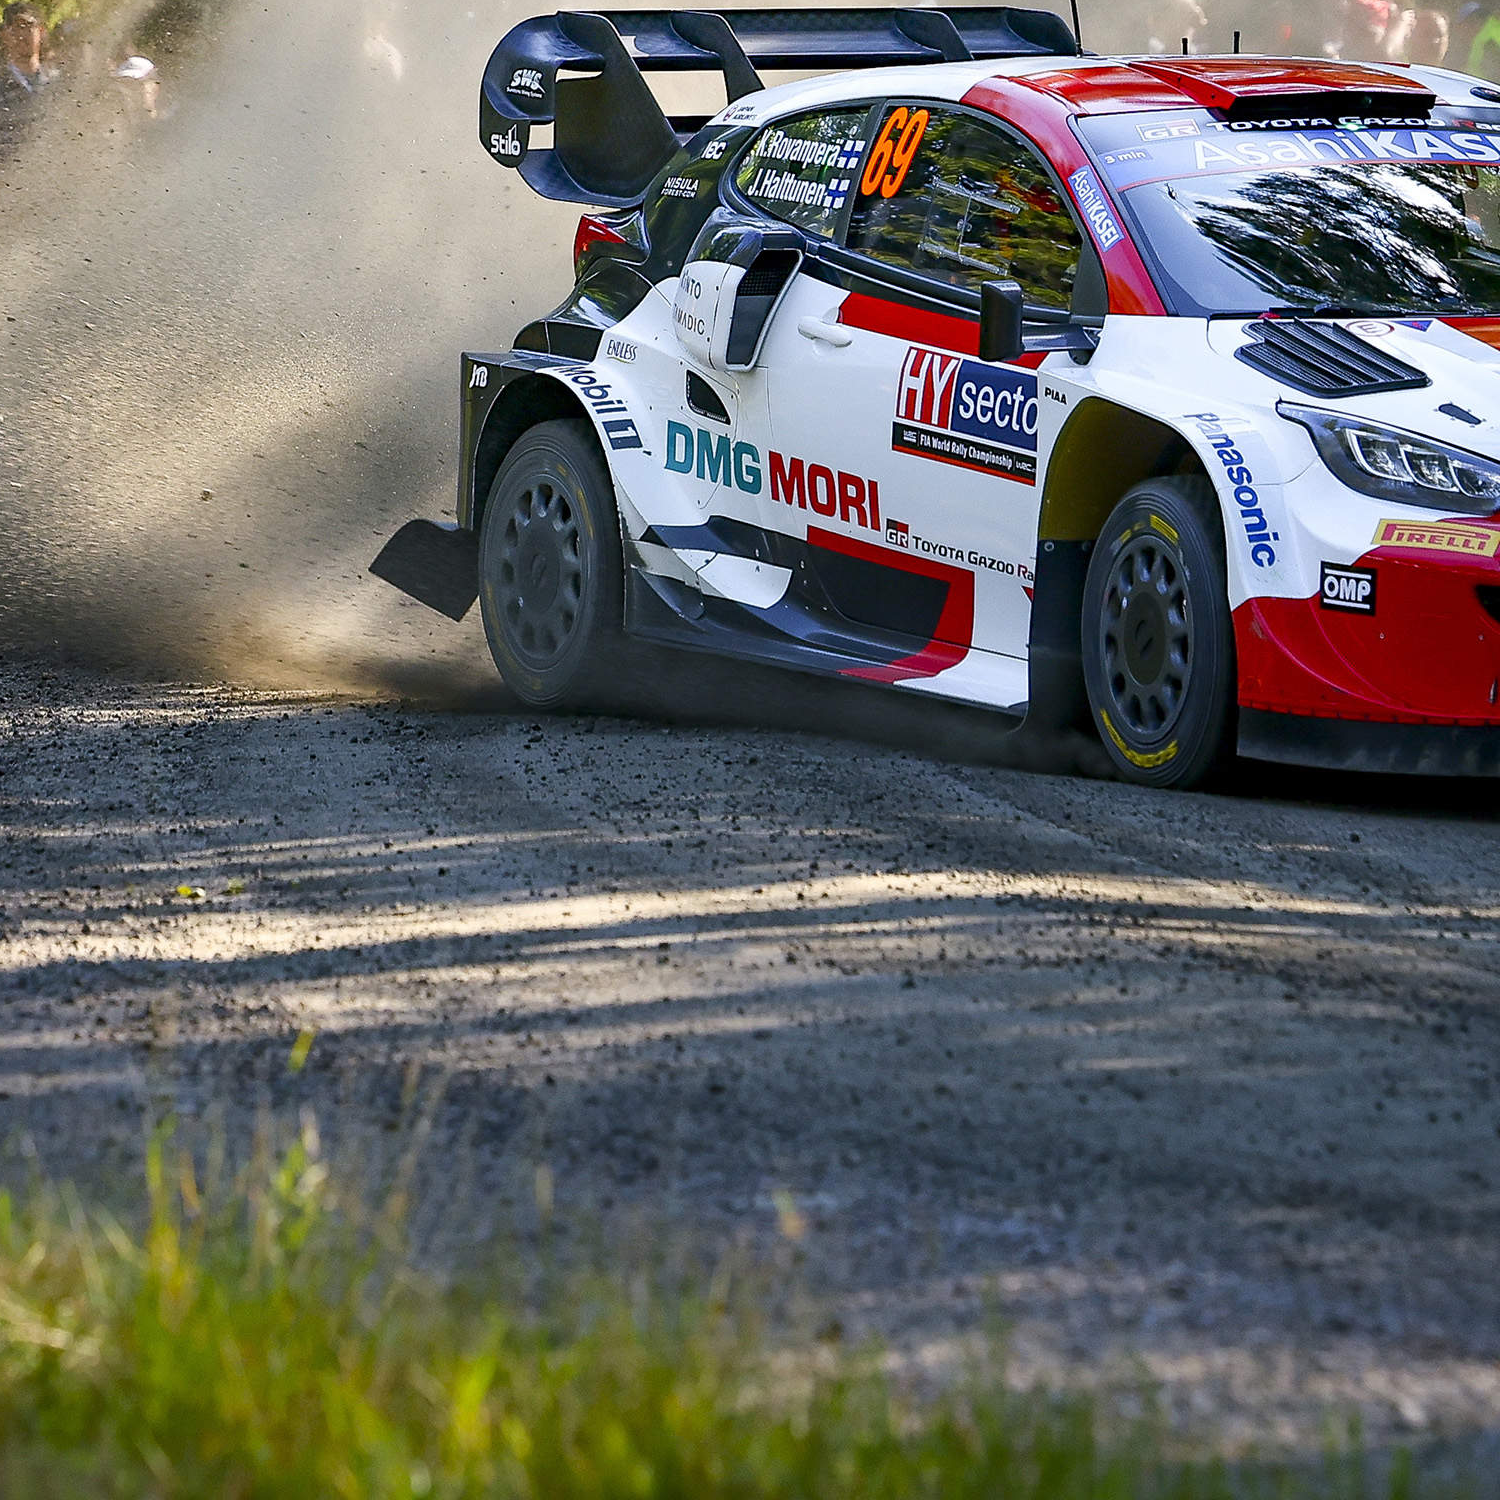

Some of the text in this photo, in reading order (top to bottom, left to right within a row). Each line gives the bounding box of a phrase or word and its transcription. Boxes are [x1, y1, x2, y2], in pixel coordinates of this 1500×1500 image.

[510, 69, 545, 93] SWS
[1143, 125, 1198, 139] GR
[1206, 117, 1331, 132] TOYOTA
[1338, 116, 1446, 127] GAZOO
[861, 106, 930, 198] 69
[1104, 155, 1116, 164] 3
[664, 176, 698, 191] NISULA
[1071, 170, 1120, 248] AsahiKASEI
[553, 366, 629, 415] Mobil
[898, 347, 1039, 436] HY secto
[1045, 386, 1067, 405] PIAA
[920, 434, 931, 447] FIA
[932, 437, 950, 453] World
[951, 441, 968, 459] Rally
[968, 446, 1012, 470] Championship
[663, 419, 881, 532] DMG MORI
[1183, 411, 1280, 569] Panasonic
[887, 529, 908, 548] GR
[912, 535, 965, 562] TOYOTA
[968, 551, 1015, 575] GAZOO
[1380, 523, 1491, 551] PIRELLI
[1323, 576, 1372, 602] OMP
